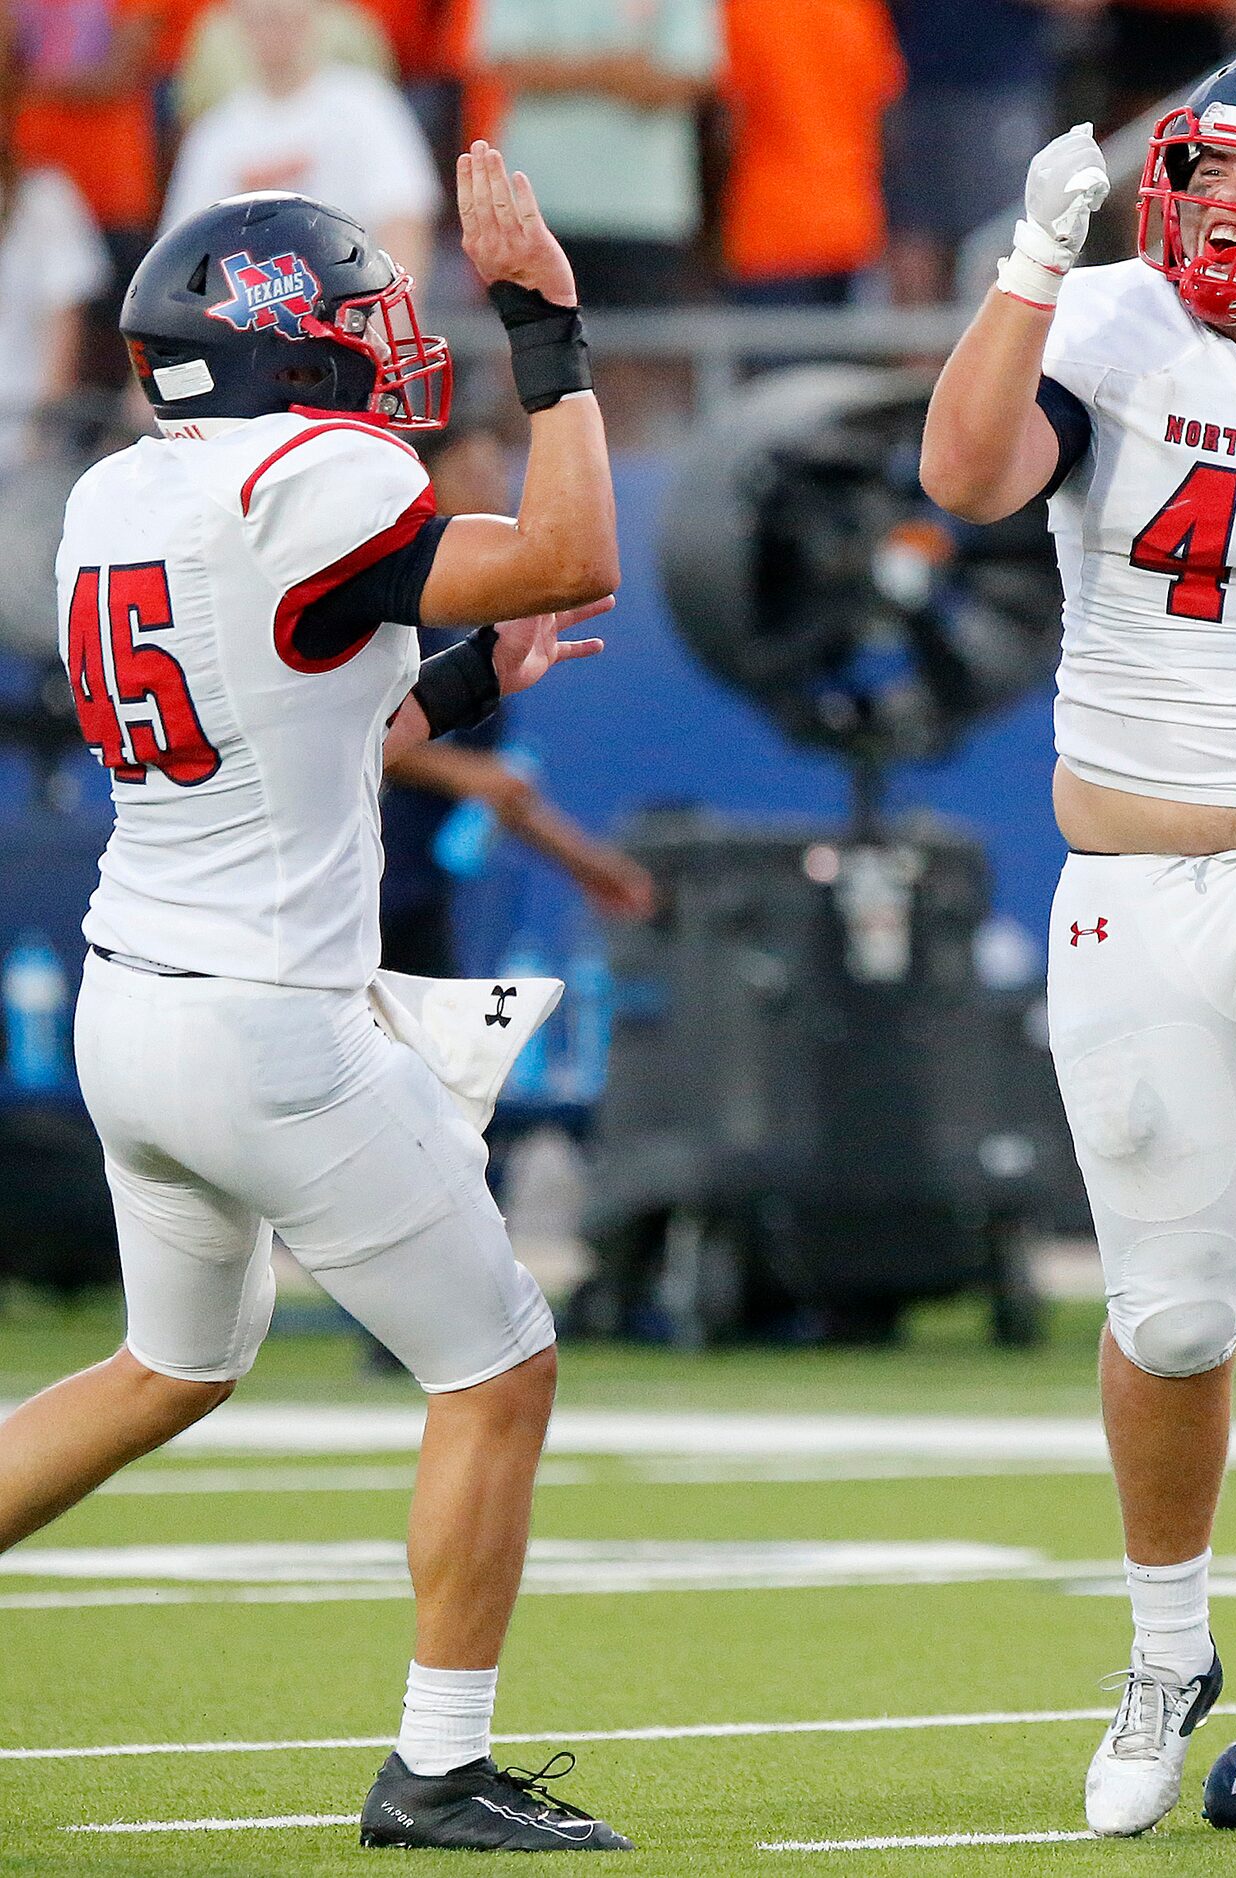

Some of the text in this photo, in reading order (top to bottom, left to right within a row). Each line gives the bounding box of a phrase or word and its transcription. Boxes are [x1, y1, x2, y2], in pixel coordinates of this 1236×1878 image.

[245, 272, 305, 307] TEXANS
[67, 560, 222, 787] 45
[381, 1800, 415, 1829] VAPOR
